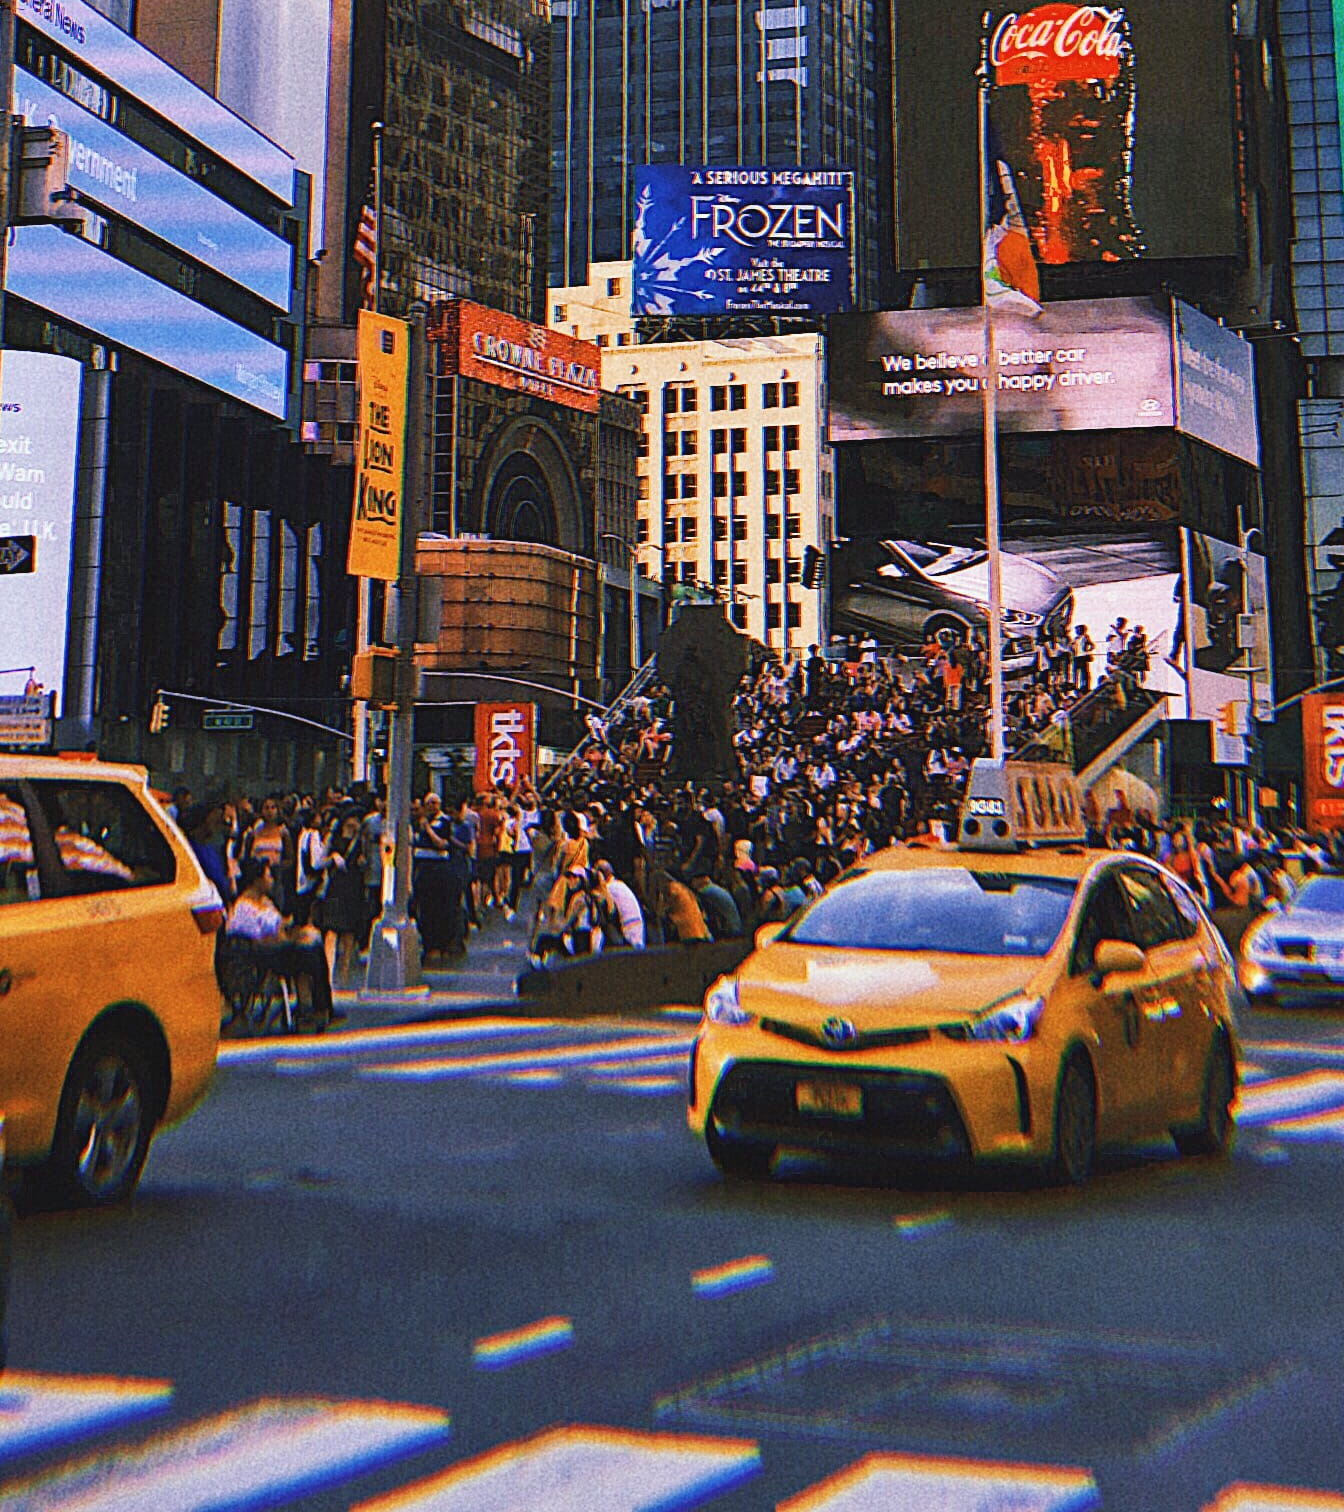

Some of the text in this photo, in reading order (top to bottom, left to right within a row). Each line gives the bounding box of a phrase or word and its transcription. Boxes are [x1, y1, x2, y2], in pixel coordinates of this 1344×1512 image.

[54, 1, 87, 45] News
[990, 6, 1125, 67] Coca-Cola
[67, 138, 139, 203] vernment
[707, 171, 767, 185] SERIOUS
[690, 194, 845, 248] FROZEN
[736, 269, 775, 282] JAMES
[777, 269, 832, 282] THEATRE
[471, 331, 597, 388] CROWNE PLAZA
[881, 347, 1086, 372] We believe better car
[882, 369, 1116, 397] makes you happy driver.
[356, 471, 397, 522] KING
[490, 708, 526, 786] tkts
